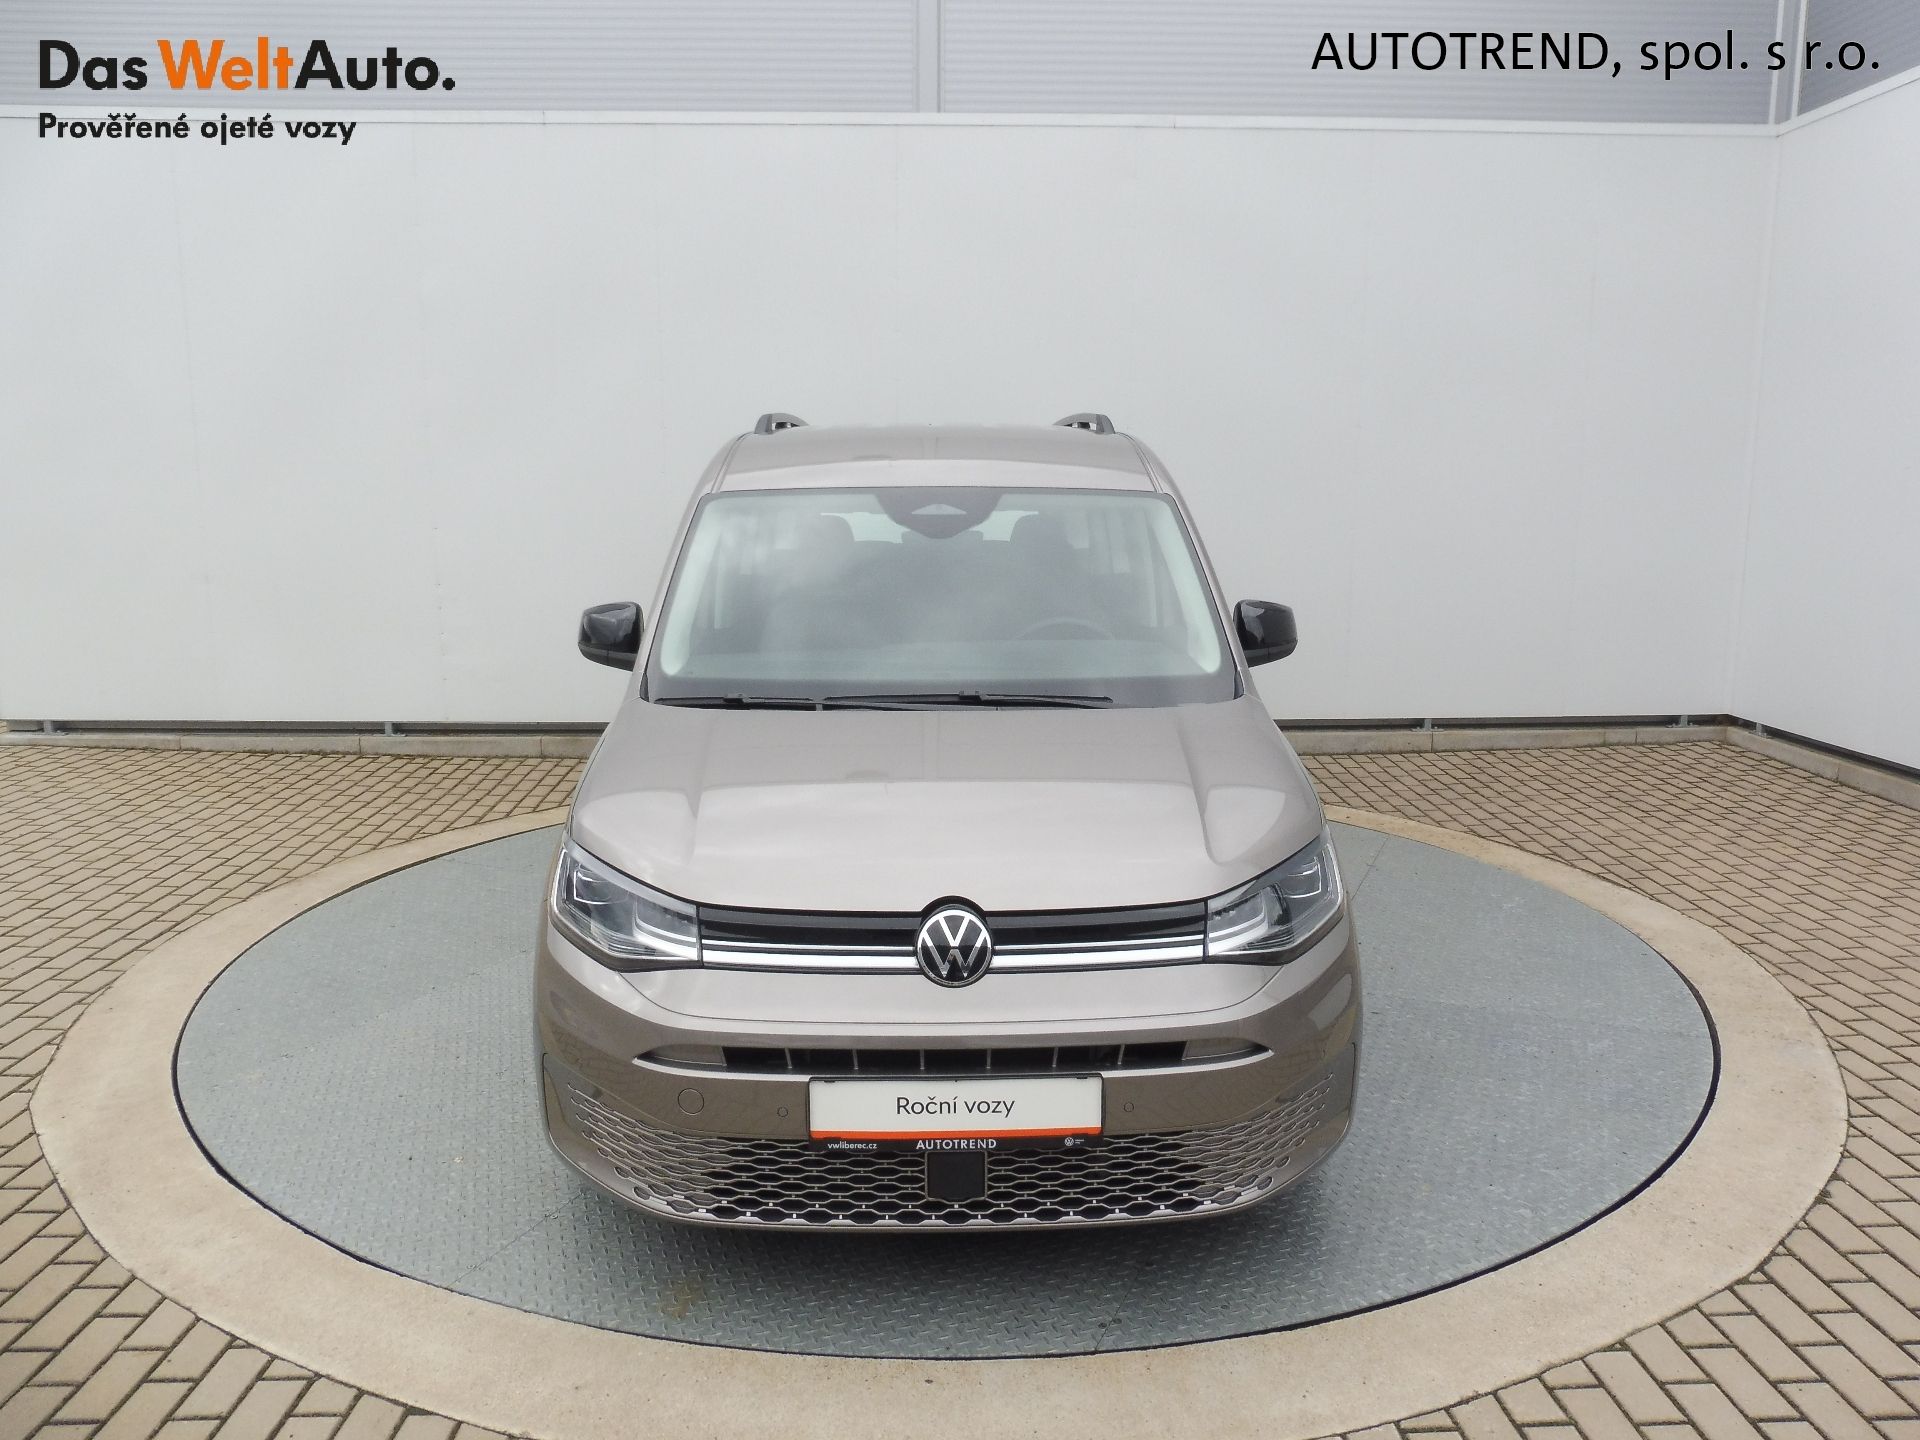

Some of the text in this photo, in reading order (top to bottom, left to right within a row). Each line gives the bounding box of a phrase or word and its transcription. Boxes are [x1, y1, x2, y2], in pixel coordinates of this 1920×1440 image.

[896, 1095, 1016, 1118] Roční vozy
[827, 1140, 878, 1150] vwliberec.cz
[915, 1138, 997, 1150] AUTOTREND
